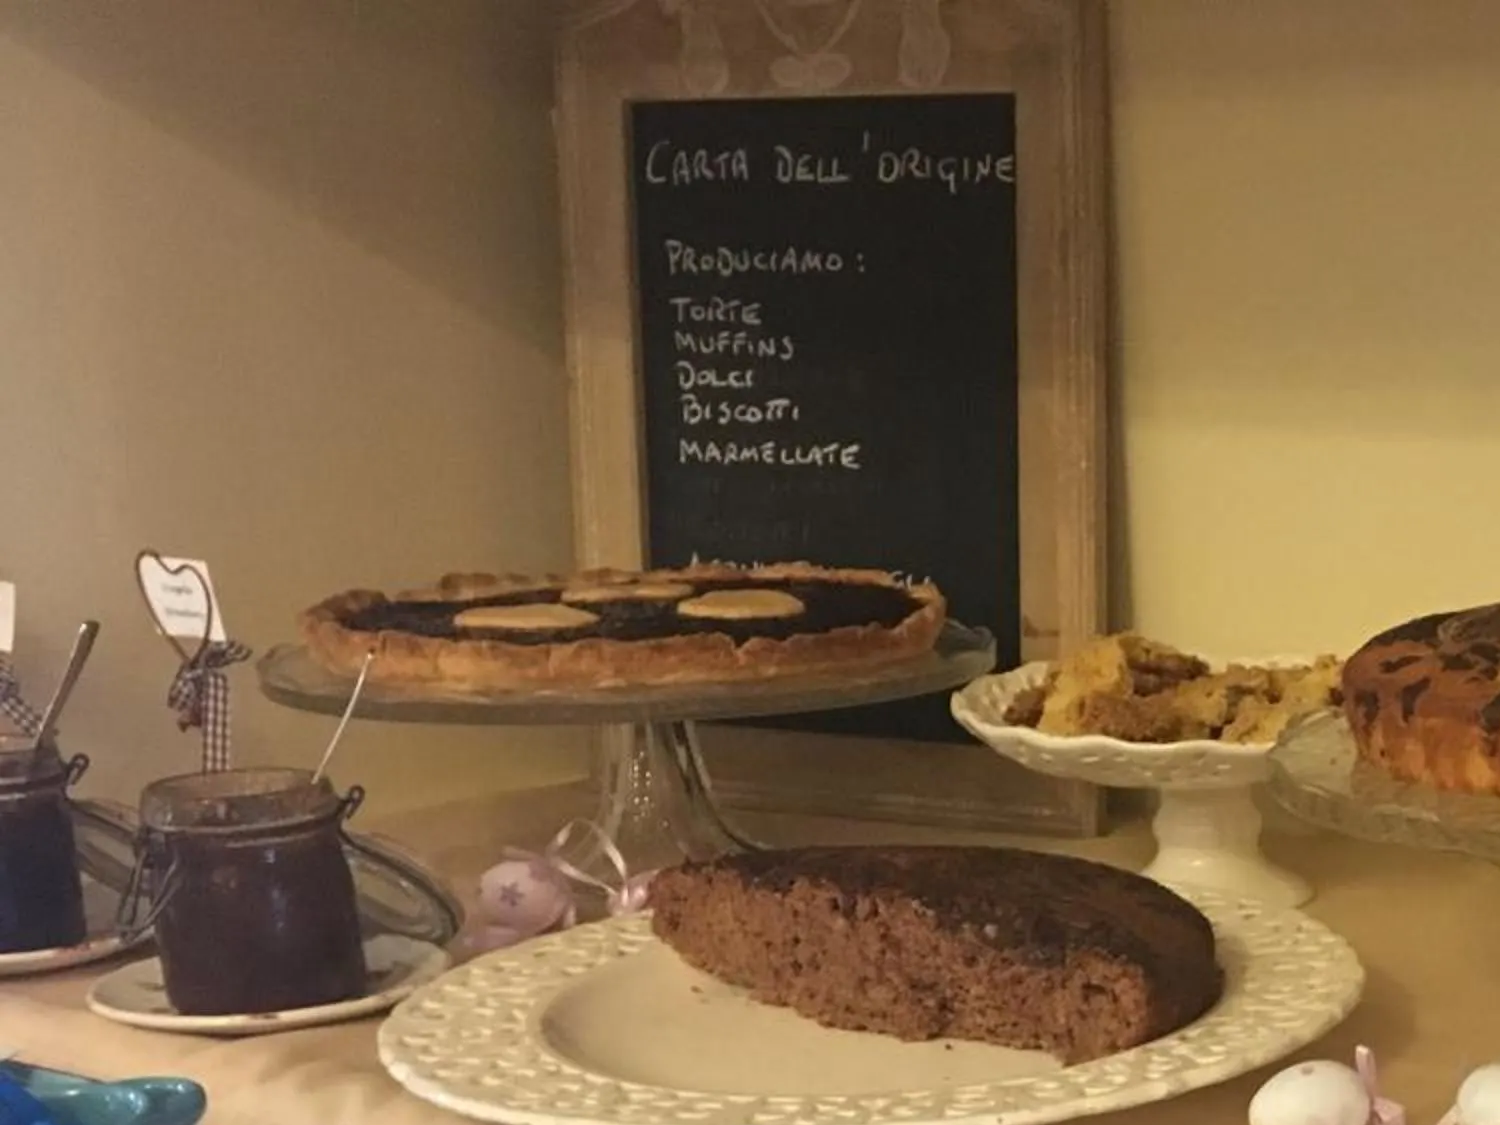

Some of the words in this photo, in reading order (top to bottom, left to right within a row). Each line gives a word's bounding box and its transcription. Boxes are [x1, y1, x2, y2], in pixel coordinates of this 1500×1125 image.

[646, 140, 748, 185] CARTA
[670, 297, 762, 325] TORTE
[674, 329, 795, 360] MUFFINS
[676, 361, 754, 390] DOLCI
[681, 393, 800, 424] BISCOTTI
[679, 438, 861, 470] MARMELLATE
